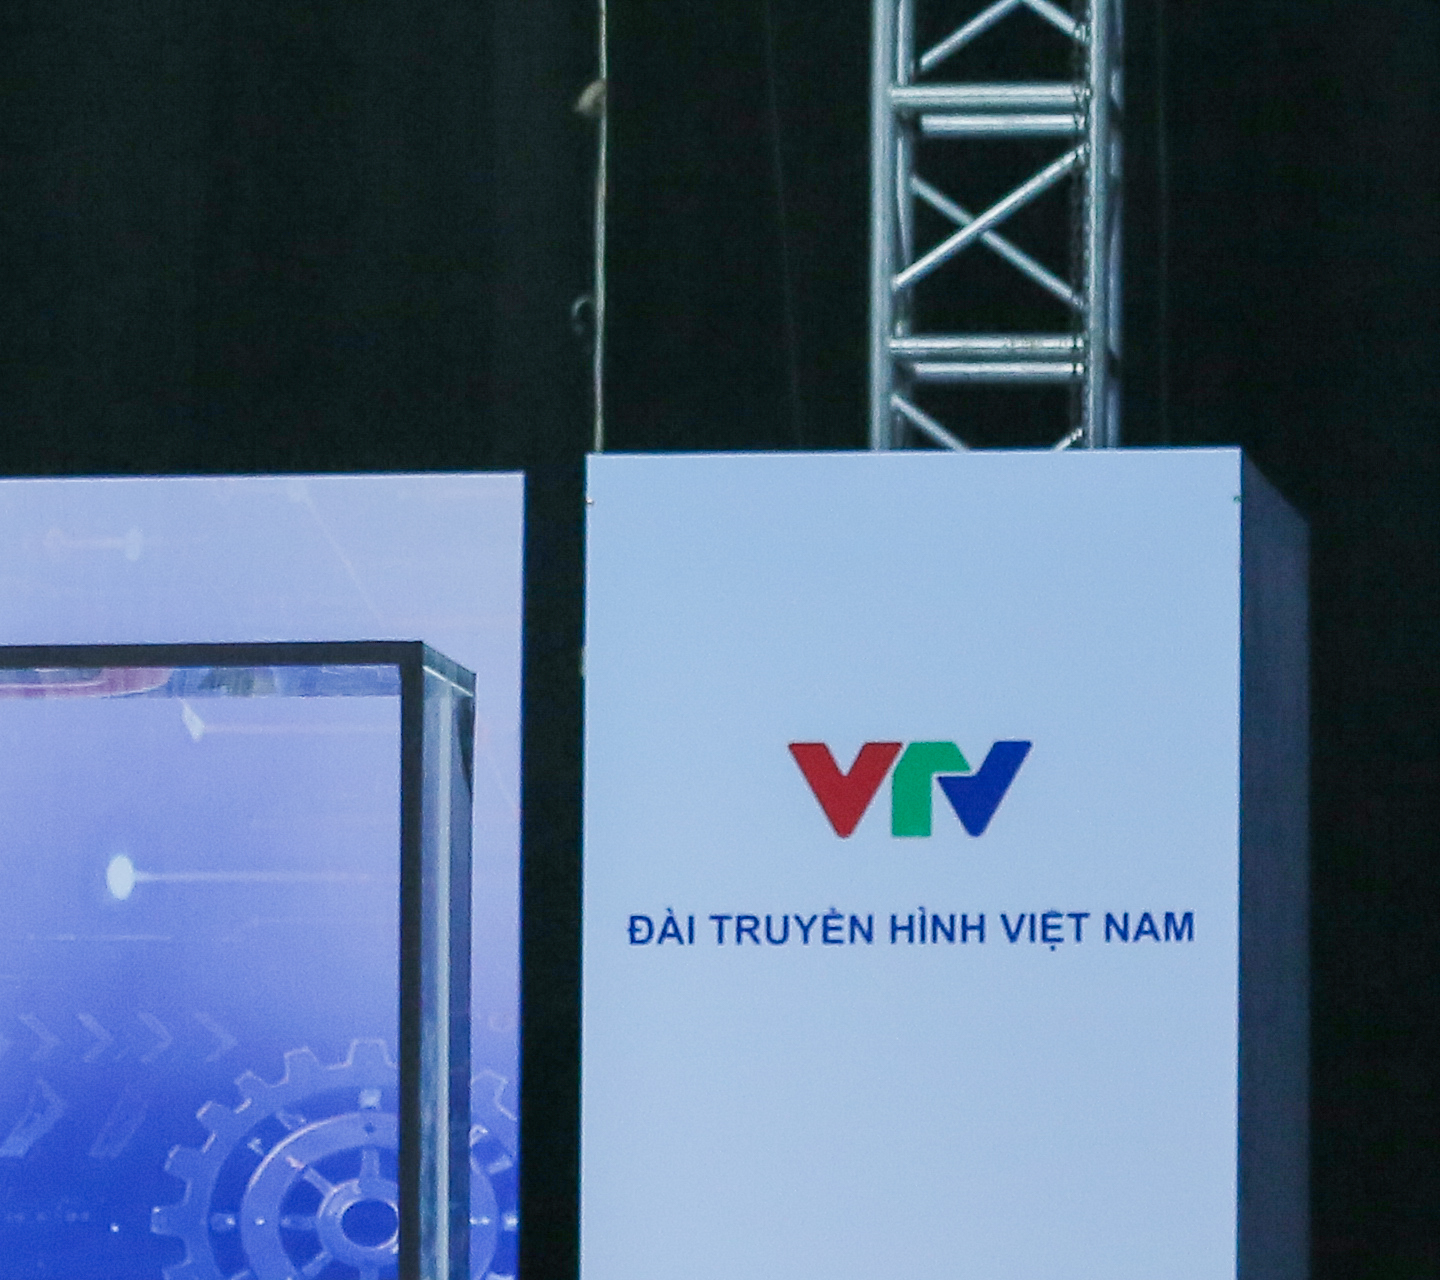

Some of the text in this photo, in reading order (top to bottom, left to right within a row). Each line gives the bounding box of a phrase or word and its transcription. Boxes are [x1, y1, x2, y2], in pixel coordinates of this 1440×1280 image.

[789, 741, 1032, 838] VTV
[627, 907, 695, 945] ĐÀI
[890, 905, 986, 944] HÌNH
[1000, 909, 1090, 952] VIỆT
[1105, 911, 1195, 943] NAM
